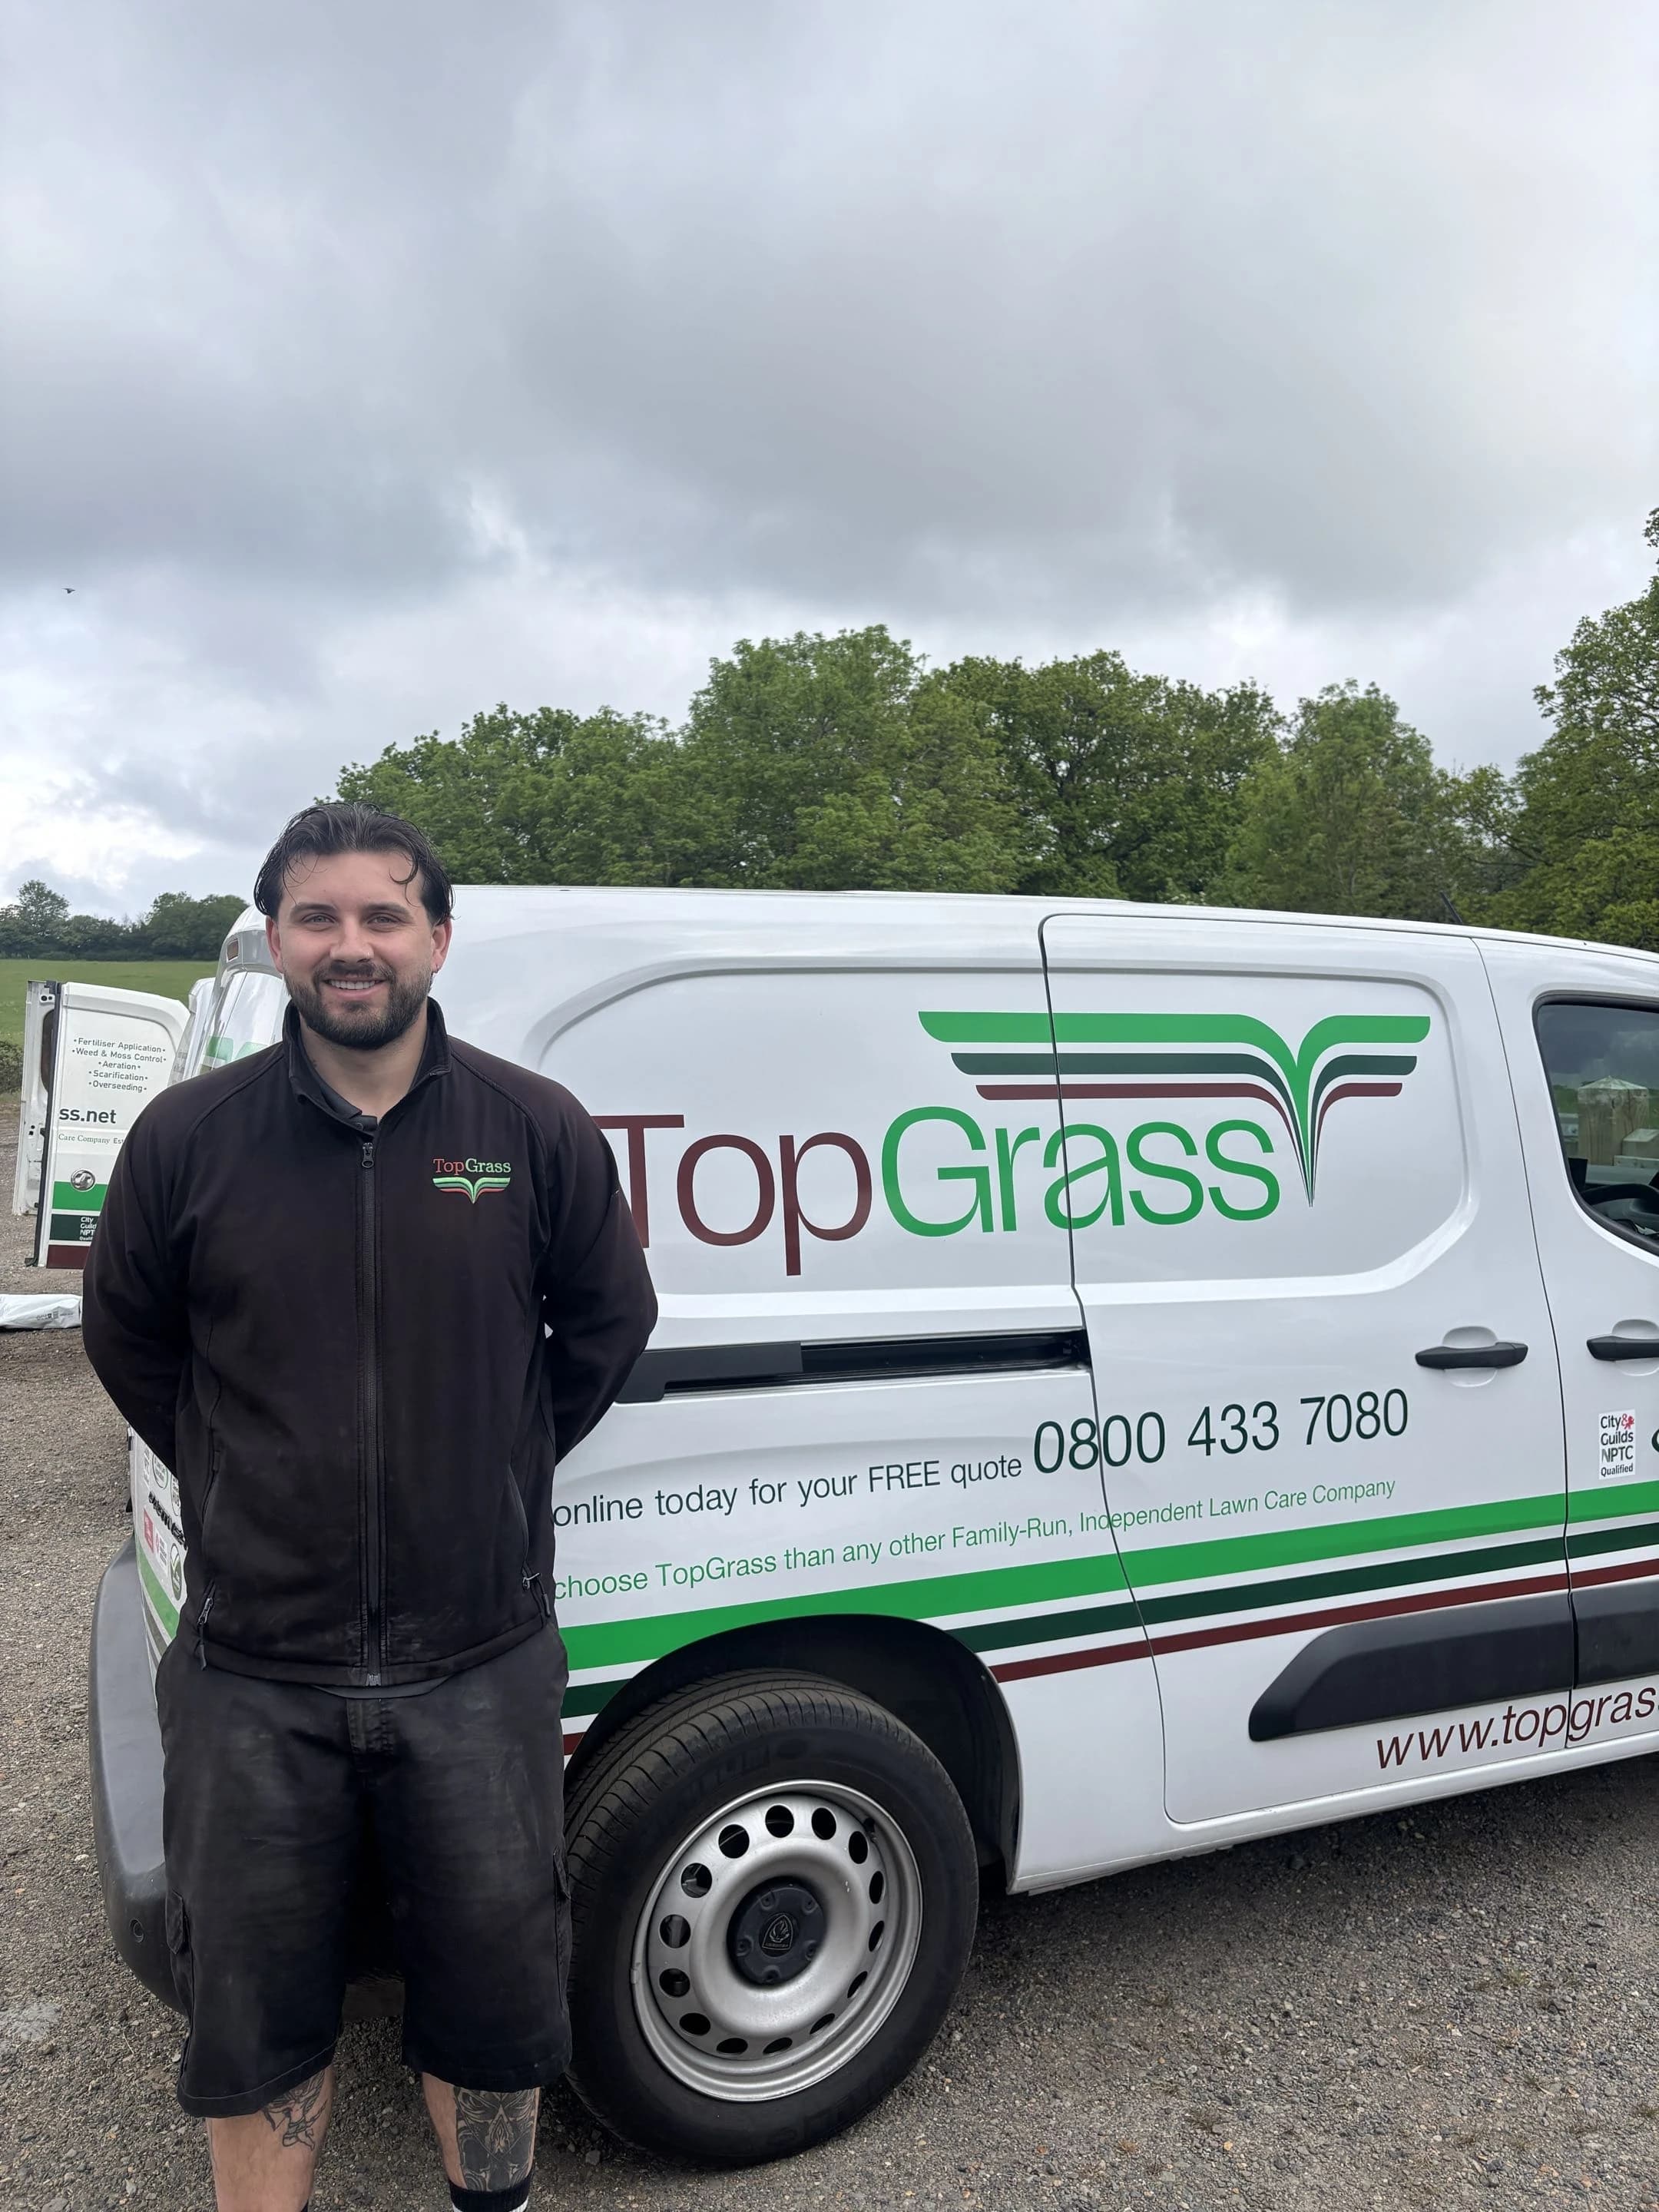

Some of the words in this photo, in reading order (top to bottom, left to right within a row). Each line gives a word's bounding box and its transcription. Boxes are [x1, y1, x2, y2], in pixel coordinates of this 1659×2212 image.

[78, 1038, 115, 1048] Fertiliser
[118, 1041, 161, 1053] Application
[76, 1047, 98, 1056] Weed
[111, 1051, 131, 1060] Moss
[134, 1053, 163, 1063] Control
[102, 1061, 137, 1070] Aeration
[93, 1070, 144, 1081] Scarification
[93, 1080, 143, 1093] Overseeding
[59, 1108, 117, 1124] ss.net
[58, 1133, 75, 1141] Care
[78, 1134, 111, 1145] Company
[432, 1157, 512, 1176] TopGrass
[591, 1105, 1281, 1277] TopGrass
[1601, 1430, 1634, 1445] Guilds
[553, 1495, 643, 1527] online
[655, 1484, 737, 1518] today
[749, 1478, 787, 1506] for
[798, 1471, 859, 1508] your
[869, 1460, 941, 1493] FREE
[951, 1454, 1022, 1488] quote
[1034, 1411, 1166, 1474] 0800
[1187, 1400, 1280, 1456] 433
[1300, 1388, 1409, 1445] 7080
[1601, 1445, 1634, 1462] NPTC
[1601, 1463, 1633, 1477] Qualified
[555, 1572, 648, 1599] choose
[656, 1555, 777, 1589] TopGrass
[783, 1547, 835, 1570] than
[843, 1541, 882, 1566] any
[889, 1532, 946, 1556] other
[952, 1517, 1073, 1548] Family-Run,
[1080, 1499, 1203, 1533] Independent
[1210, 1497, 1258, 1517] Lawn
[1265, 1488, 1307, 1510] Care
[1313, 1480, 1396, 1504] Company
[1376, 1687, 1658, 1770] www.topgras
